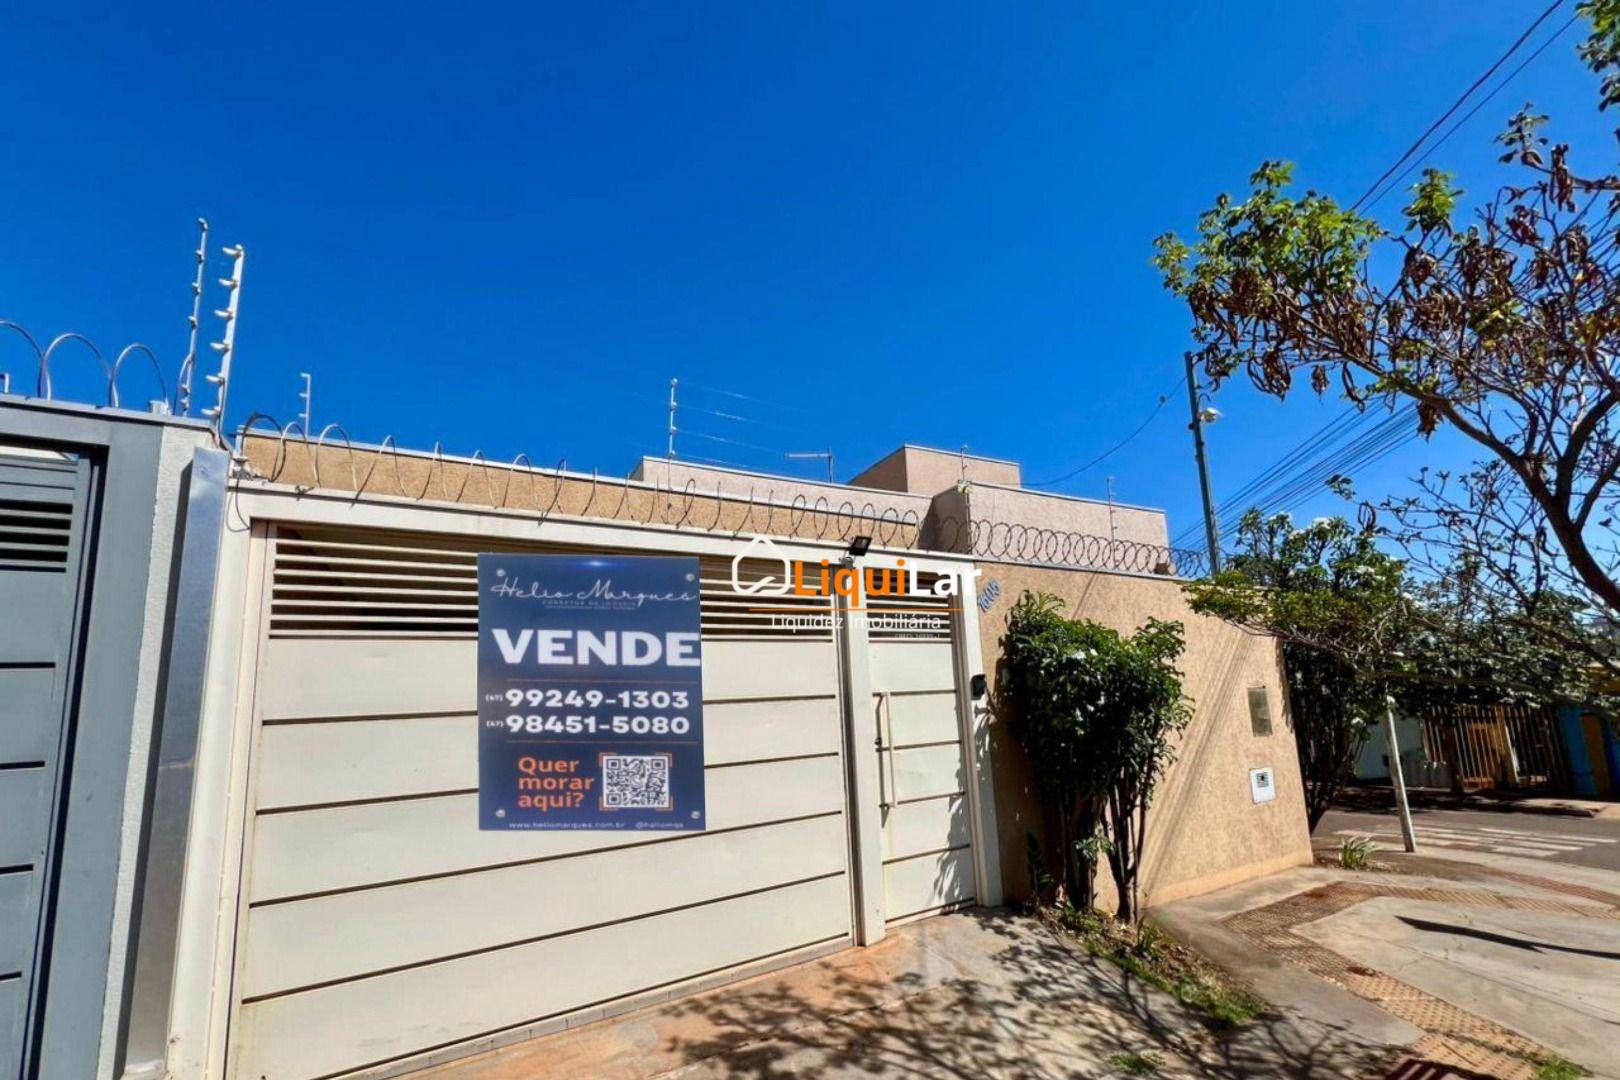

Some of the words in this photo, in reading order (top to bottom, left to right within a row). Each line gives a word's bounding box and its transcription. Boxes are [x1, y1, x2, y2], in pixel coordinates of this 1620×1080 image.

[576, 578, 697, 608] Marques
[491, 629, 701, 667] VENDE
[505, 689, 690, 709] 99249-1303
[505, 715, 690, 734] 98451-5080
[518, 757, 579, 775] Quer
[518, 775, 595, 790] morar
[518, 793, 585, 811] aqui?
